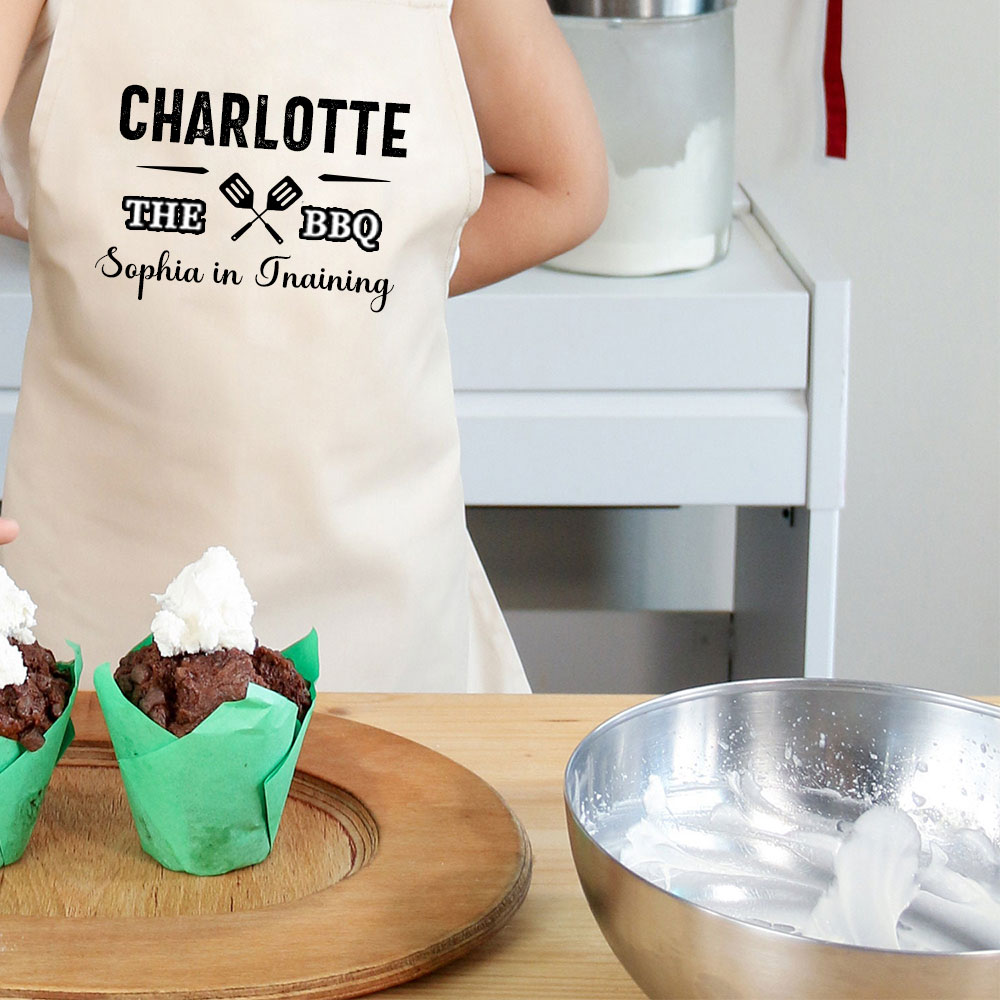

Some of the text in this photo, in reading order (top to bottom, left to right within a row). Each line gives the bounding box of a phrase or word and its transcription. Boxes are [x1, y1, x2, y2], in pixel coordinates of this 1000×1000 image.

[119, 84, 411, 158] CHARLOTTE
[122, 196, 382, 252] THE BBQ
[95, 246, 205, 301] Sophia
[213, 261, 244, 286] in
